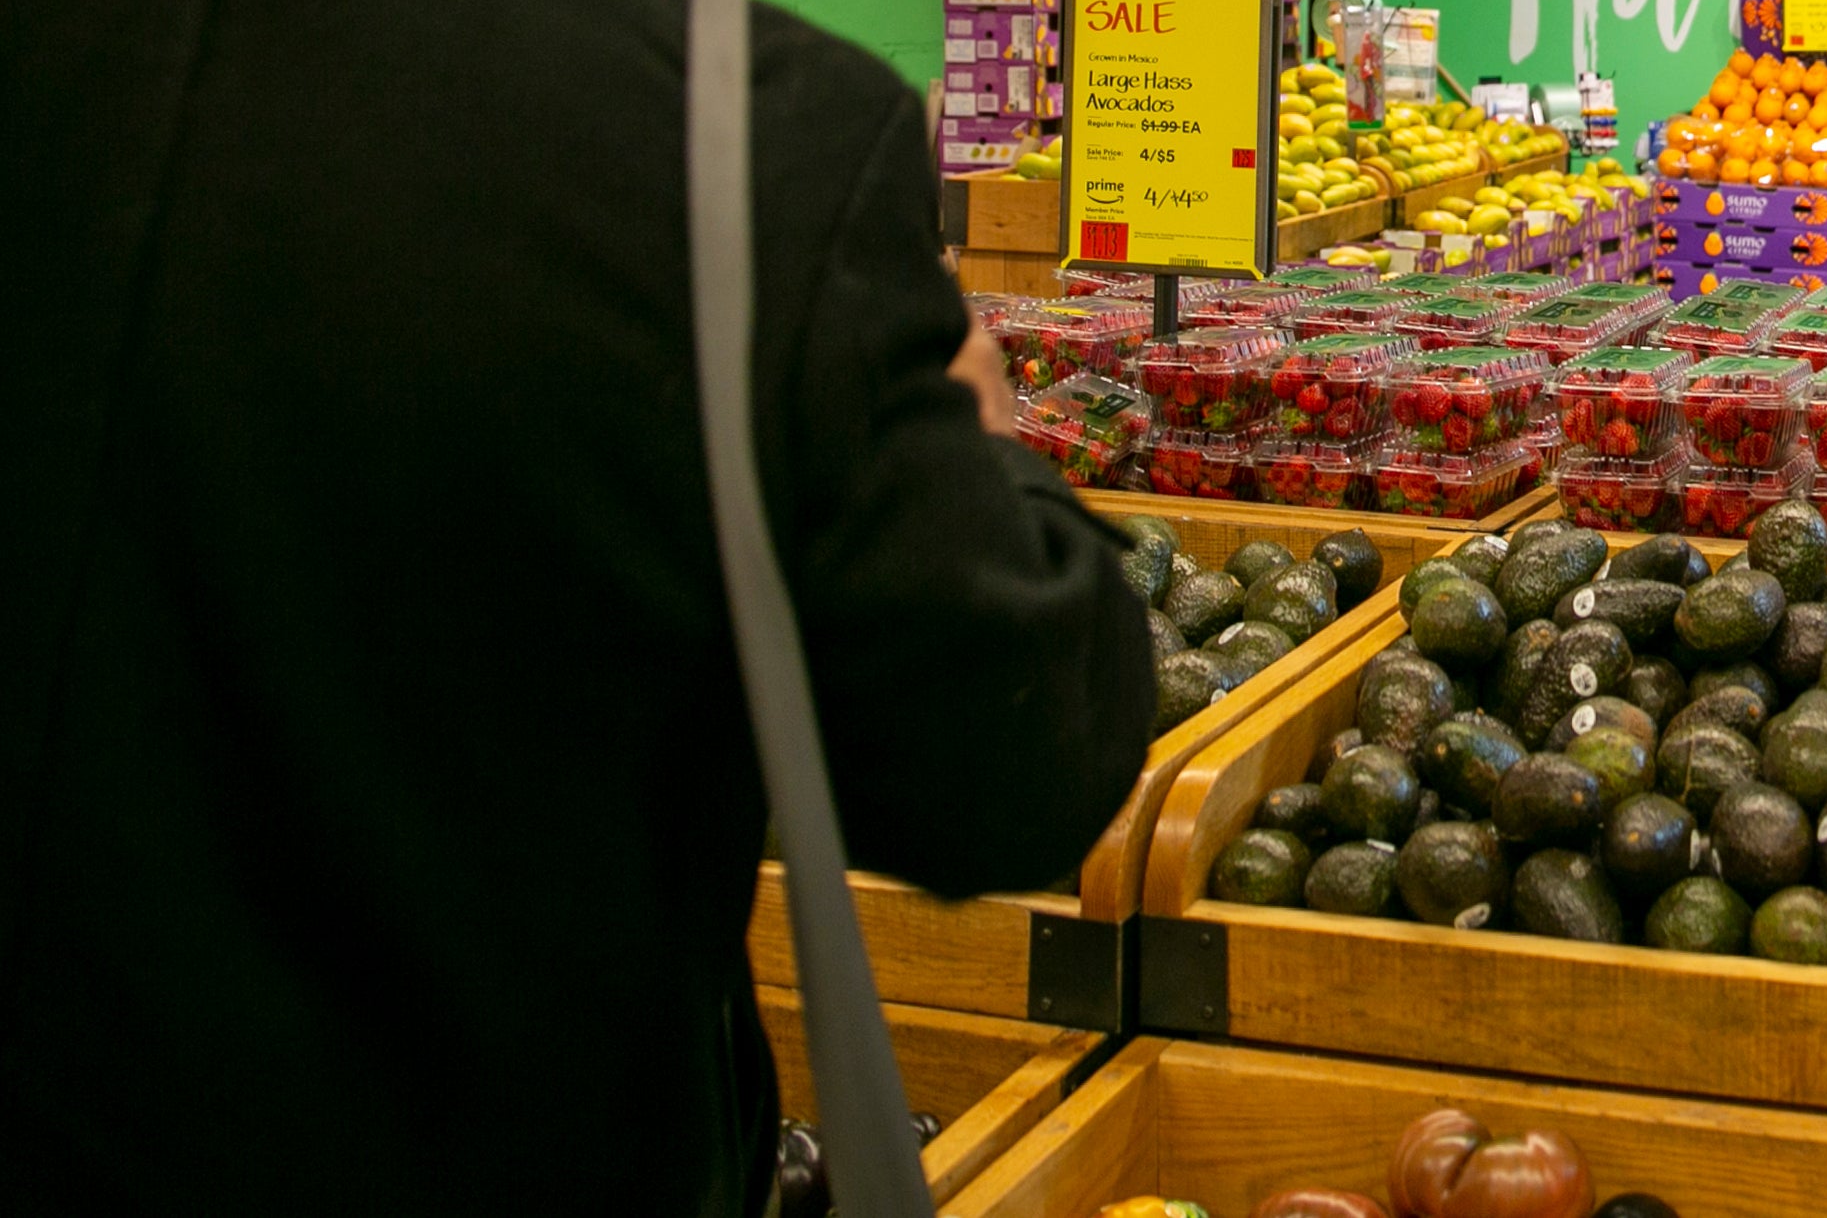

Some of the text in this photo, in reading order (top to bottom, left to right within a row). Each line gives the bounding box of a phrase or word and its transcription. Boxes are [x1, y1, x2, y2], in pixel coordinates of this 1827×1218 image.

[1085, 0, 1176, 34] SALE
[1088, 53, 1159, 65] Grown in Mexico
[1088, 70, 1193, 93] Large Hass
[1086, 93, 1175, 113] Avocados
[1087, 118, 1202, 134] Regular Price: $1.99 EA
[1086, 147, 1176, 164] Sale Price: 4/$5
[1086, 178, 1125, 193] prime
